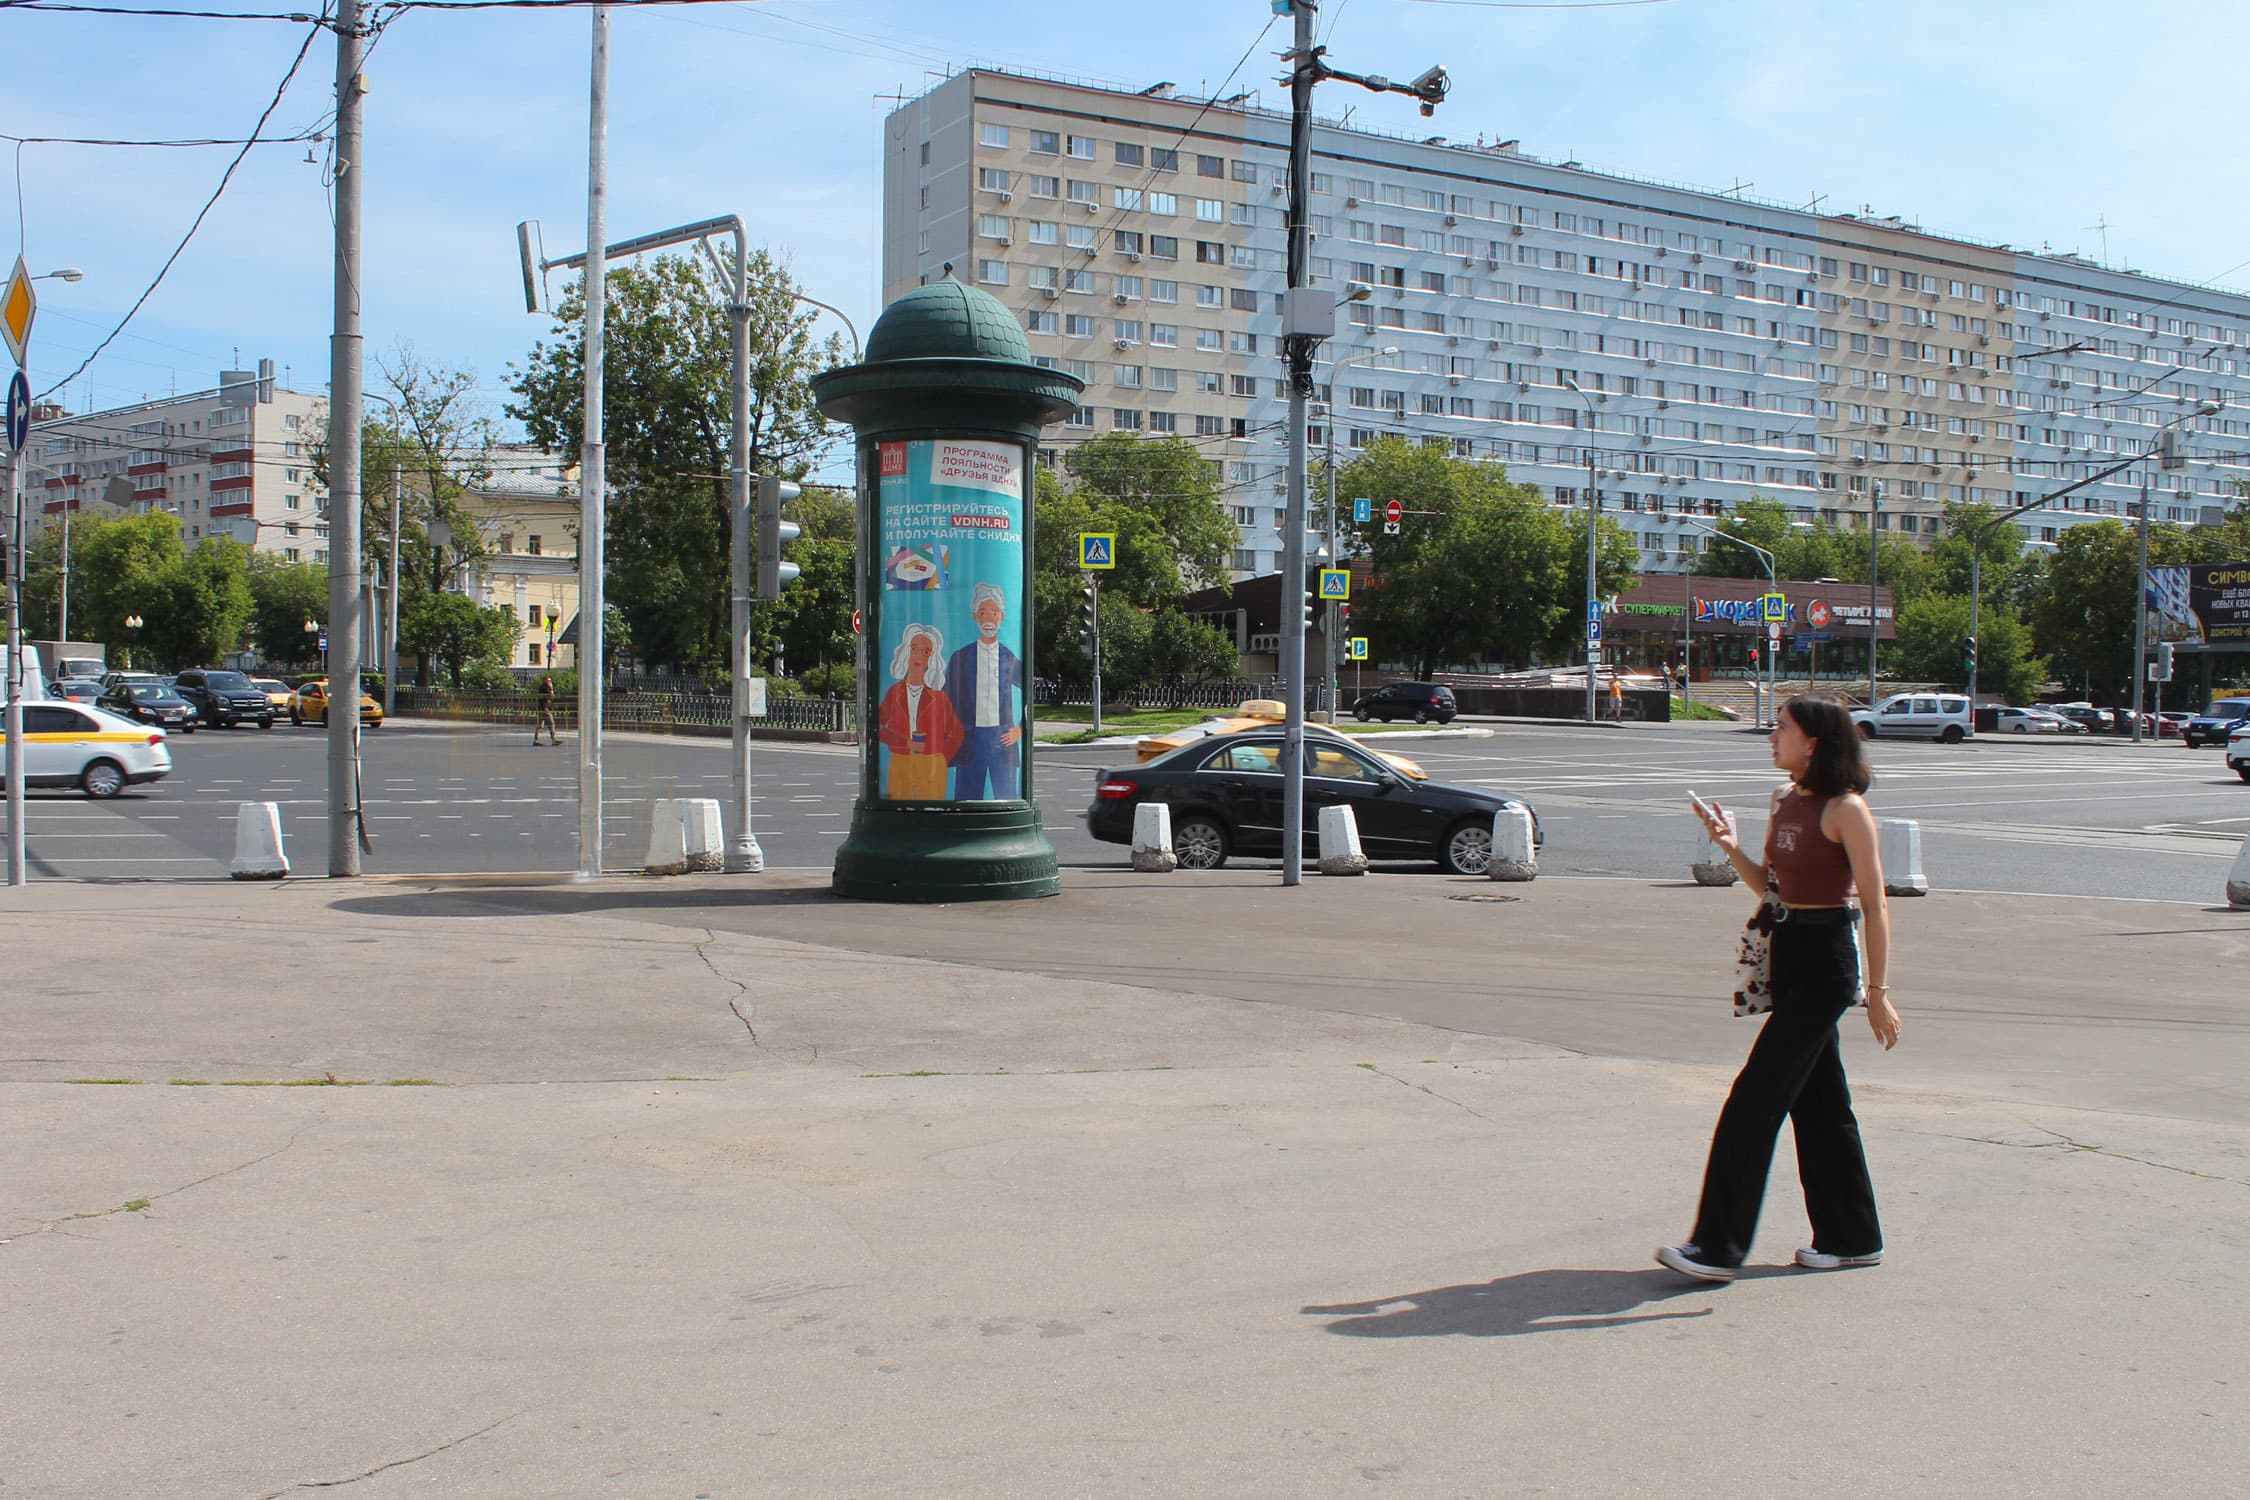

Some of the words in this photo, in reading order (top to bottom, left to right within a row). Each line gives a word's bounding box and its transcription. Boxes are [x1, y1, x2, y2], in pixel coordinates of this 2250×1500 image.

[943, 446, 1009, 464] ПРОГРАММА
[942, 456, 1010, 475] ЛОЯЛЬНОСТИ
[886, 503, 1009, 516] РЕГИСТРИРУЙТЕСЬ
[885, 517, 900, 528] НА
[903, 515, 947, 527] САЙТЕ
[953, 516, 1009, 529] VDNH.RU
[885, 531, 893, 541] И
[896, 527, 975, 540] ПОЛУЧАЙТЕ
[2208, 571, 2250, 584] СИМВ
[1624, 603, 1687, 617] СУПЕРМАРКЕТ
[2211, 599, 2234, 609] НОВЫХ
